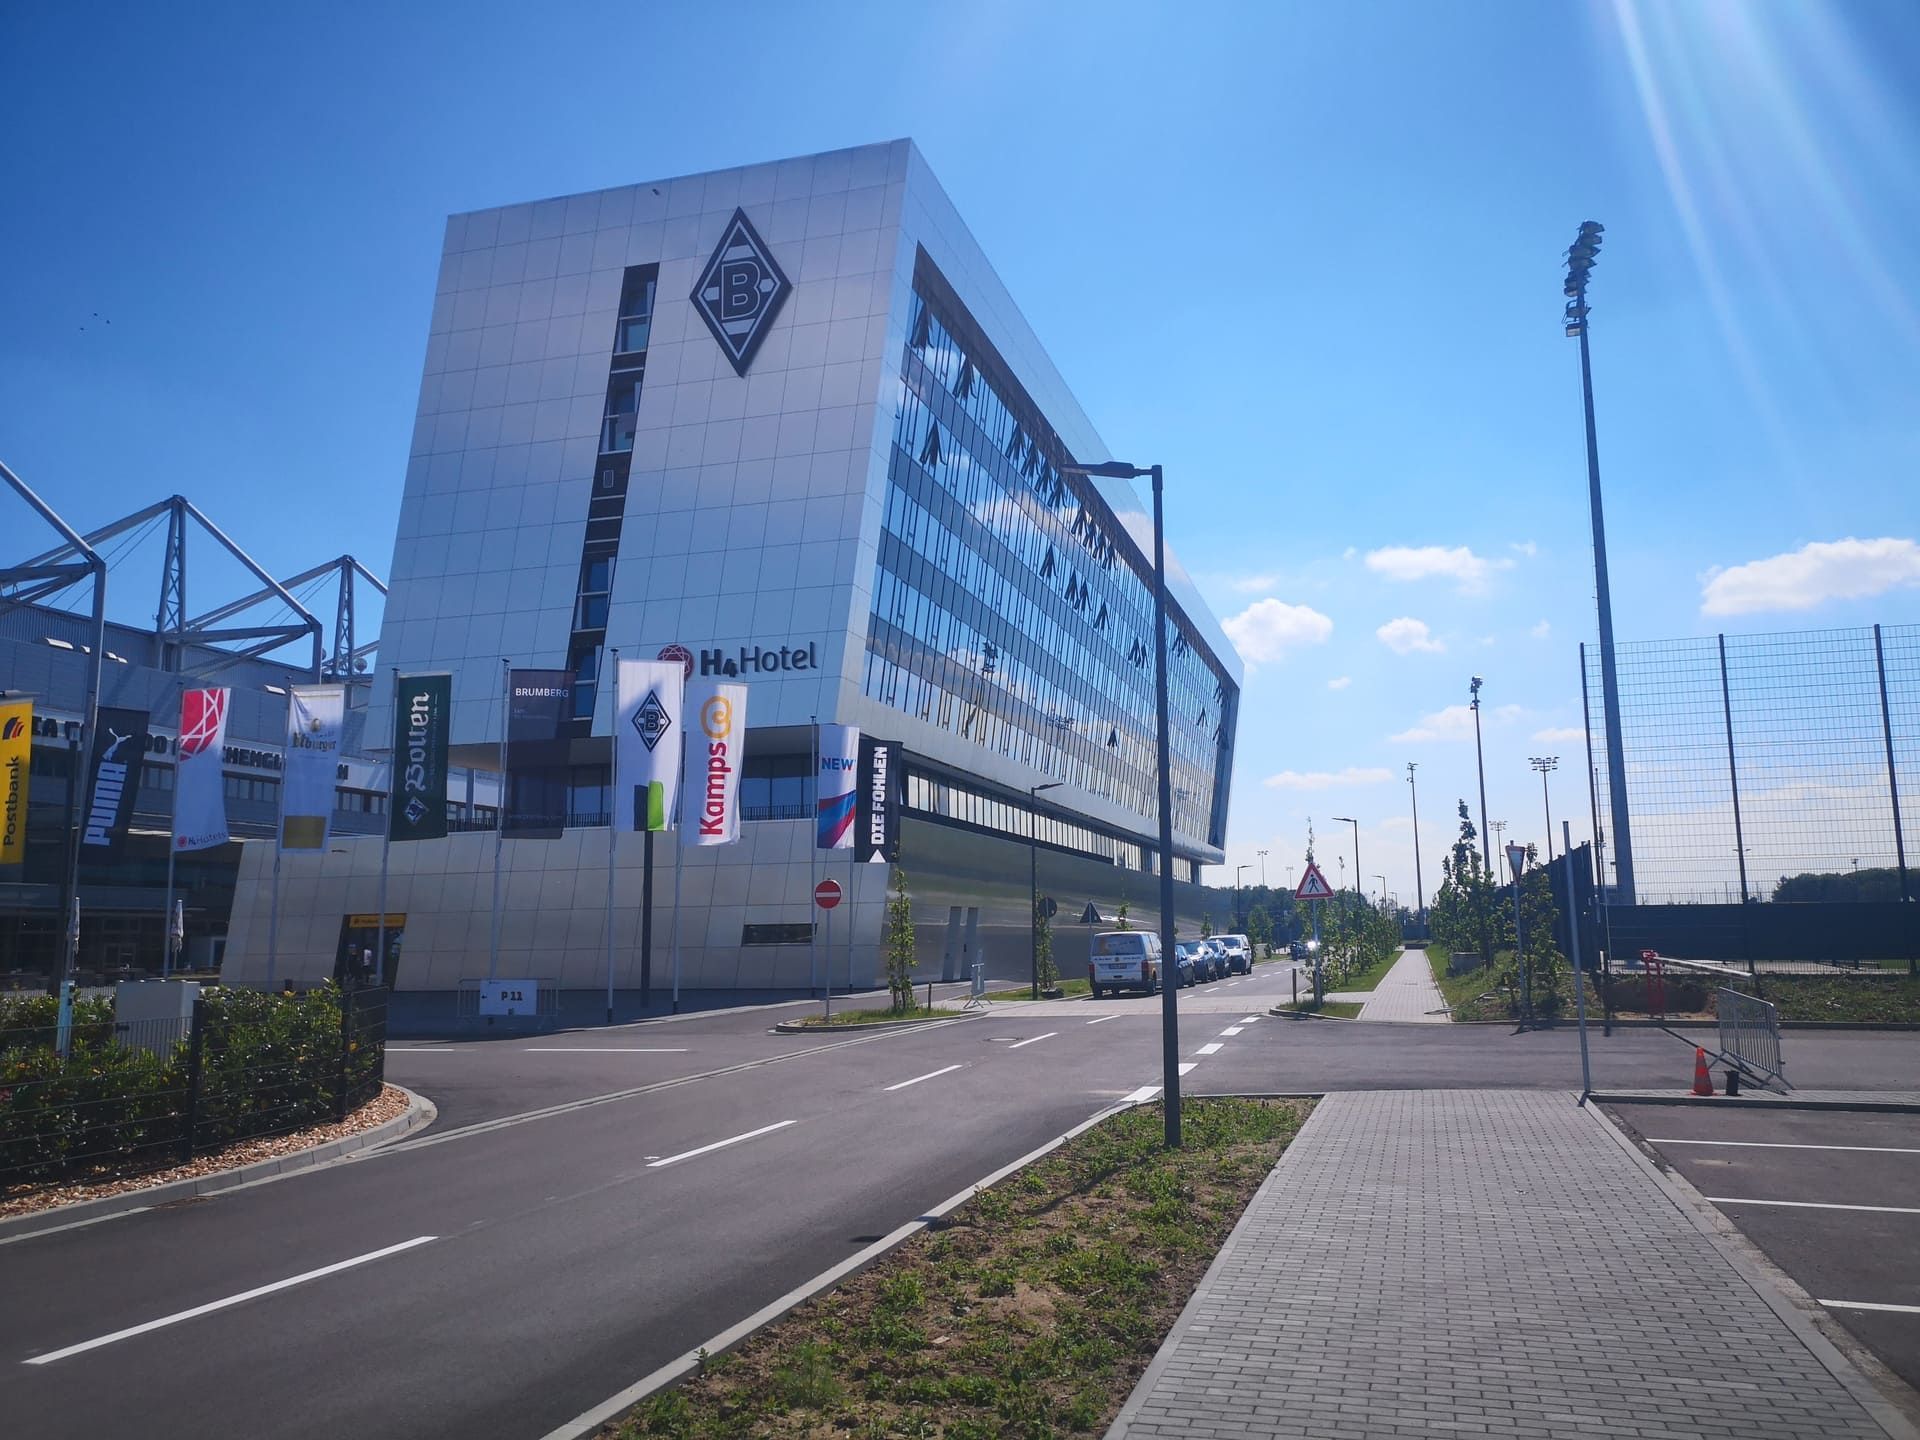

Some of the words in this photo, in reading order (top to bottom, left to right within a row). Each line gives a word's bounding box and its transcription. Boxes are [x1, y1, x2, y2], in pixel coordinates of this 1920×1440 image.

[721, 260, 761, 320] B
[515, 687, 569, 698] BRUMBERG
[699, 742, 731, 835] Kamps
[821, 757, 853, 771] NEW
[872, 746, 888, 811] FOHLEN
[3, 756, 19, 845] Postbank
[83, 761, 127, 845] PUMA
[871, 813, 885, 845] DIE
[501, 991, 508, 1001] P
